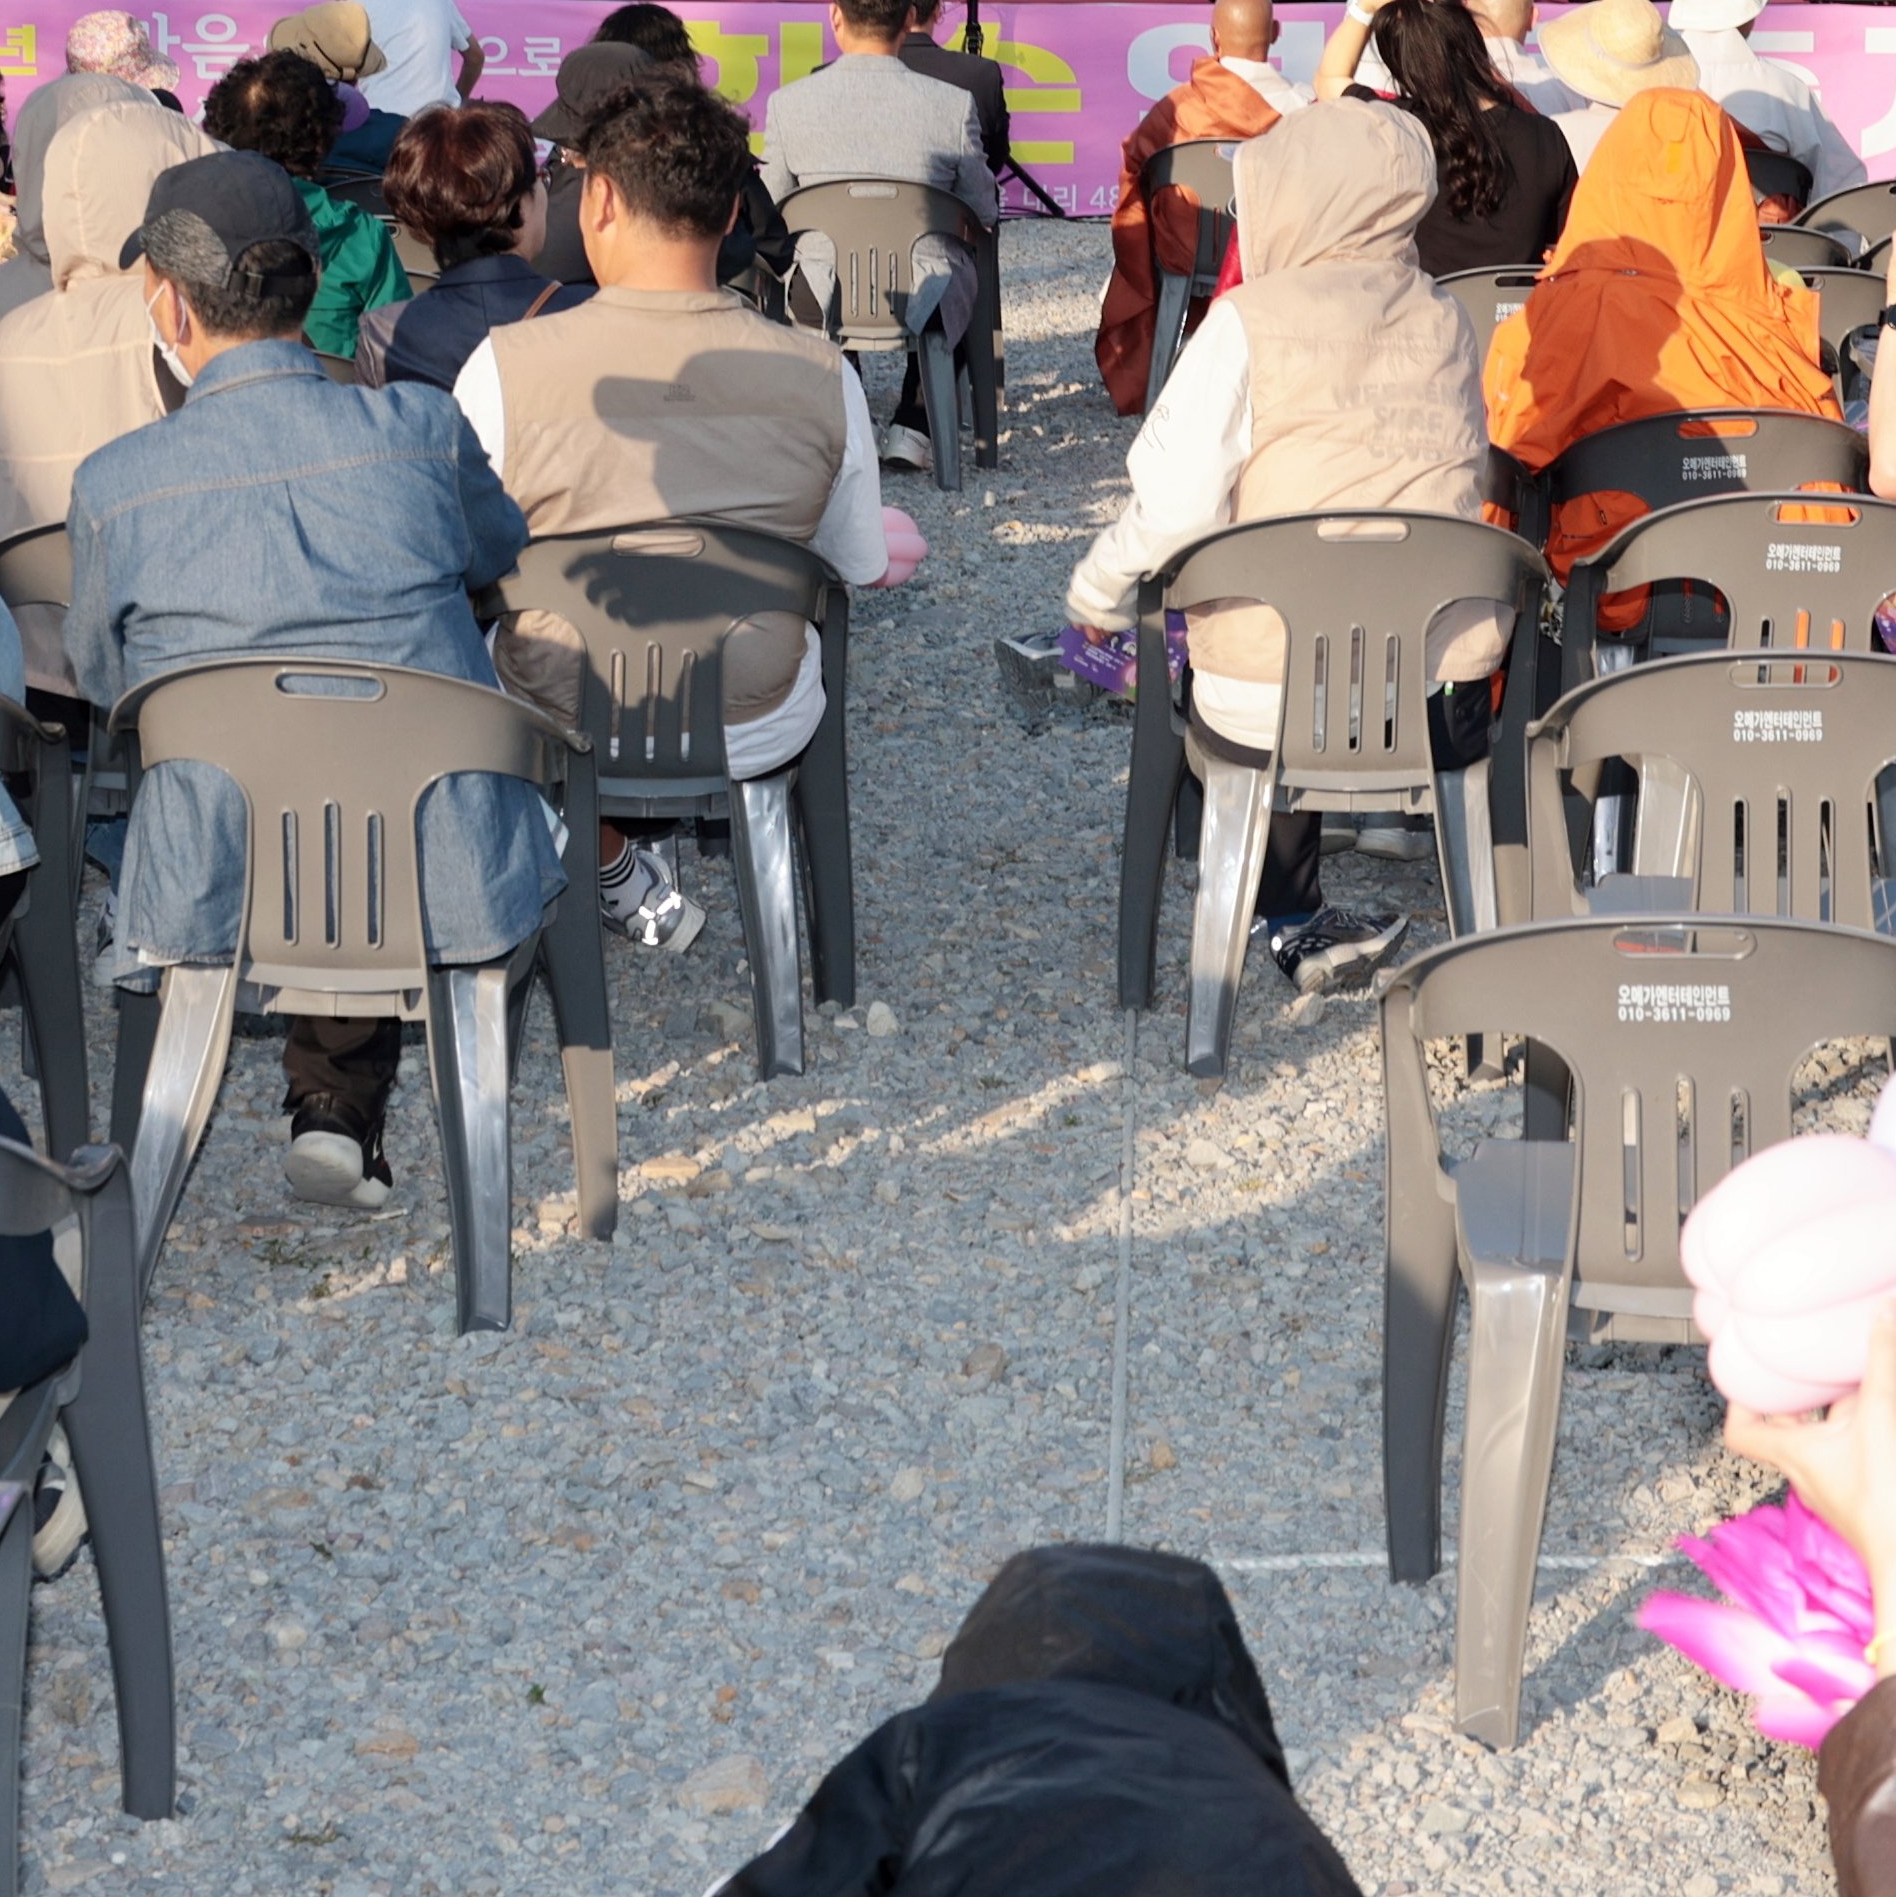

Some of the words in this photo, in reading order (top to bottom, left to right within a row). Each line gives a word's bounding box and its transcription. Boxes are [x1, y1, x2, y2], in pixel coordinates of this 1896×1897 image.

[1733, 728, 1823, 742] 010-3611-0969
[1618, 984, 1730, 1007] 오메가엔터테인먼트
[1618, 1006, 1731, 1022] 010-3611-0969
